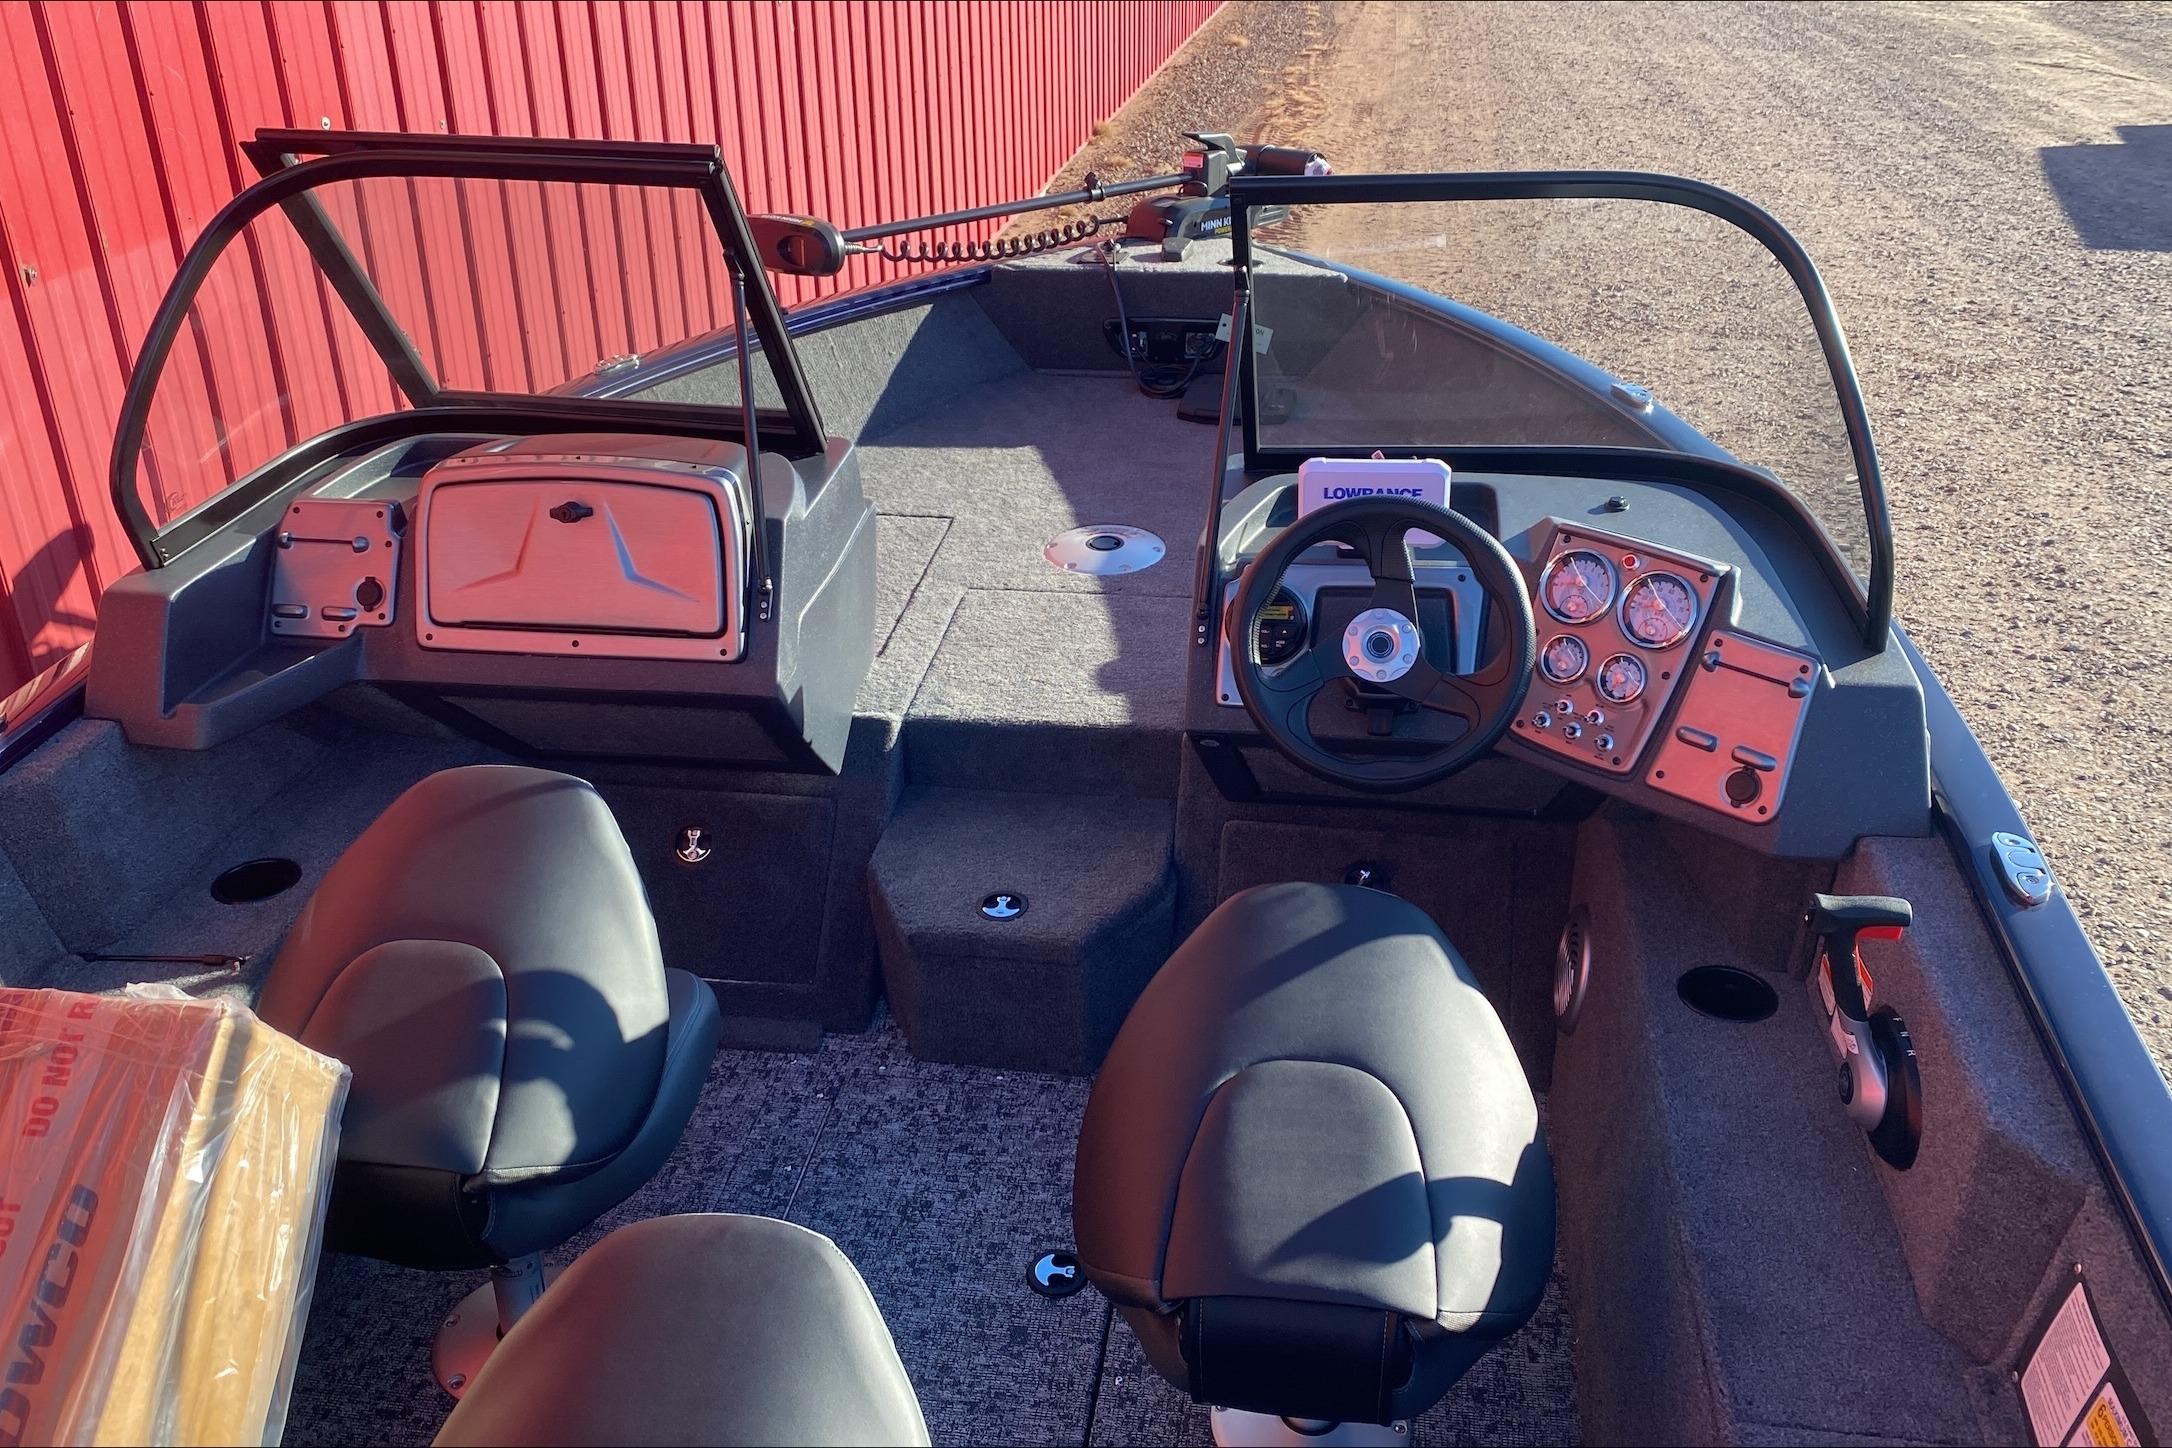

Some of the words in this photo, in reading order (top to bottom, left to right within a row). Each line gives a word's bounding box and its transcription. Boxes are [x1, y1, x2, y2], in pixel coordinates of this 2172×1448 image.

[1201, 218, 1222, 231] MINN
[67, 1002, 99, 1020] R
[41, 1026, 85, 1088] NOT
[23, 1096, 60, 1137] DO
[2097, 1404, 2107, 1418] 6
